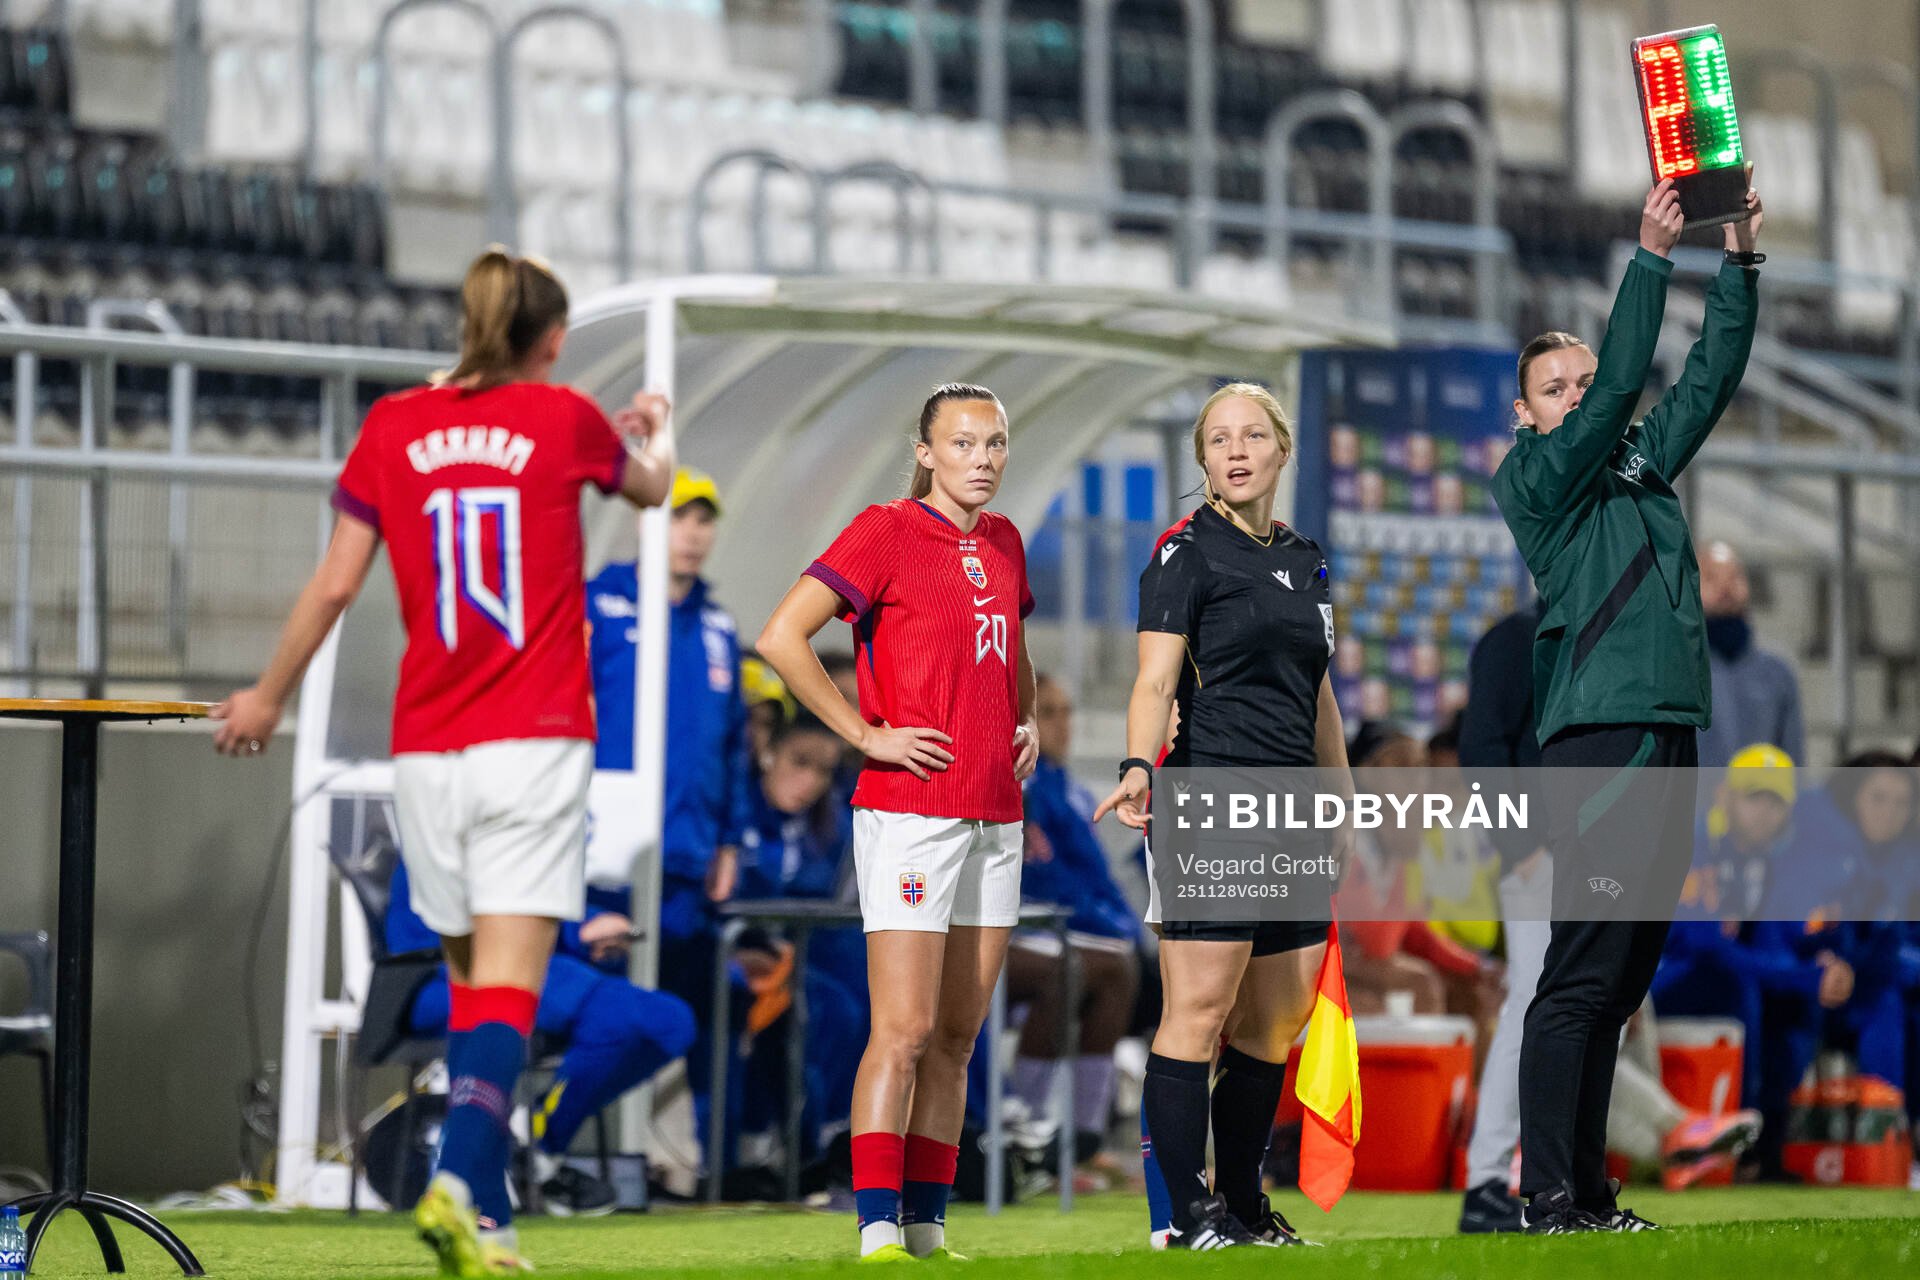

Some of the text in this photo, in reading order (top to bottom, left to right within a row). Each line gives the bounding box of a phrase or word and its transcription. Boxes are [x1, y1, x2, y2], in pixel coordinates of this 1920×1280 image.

[421, 486, 525, 653] 10
[975, 613, 1007, 666] 20
[1589, 879, 1621, 898] UEFA
